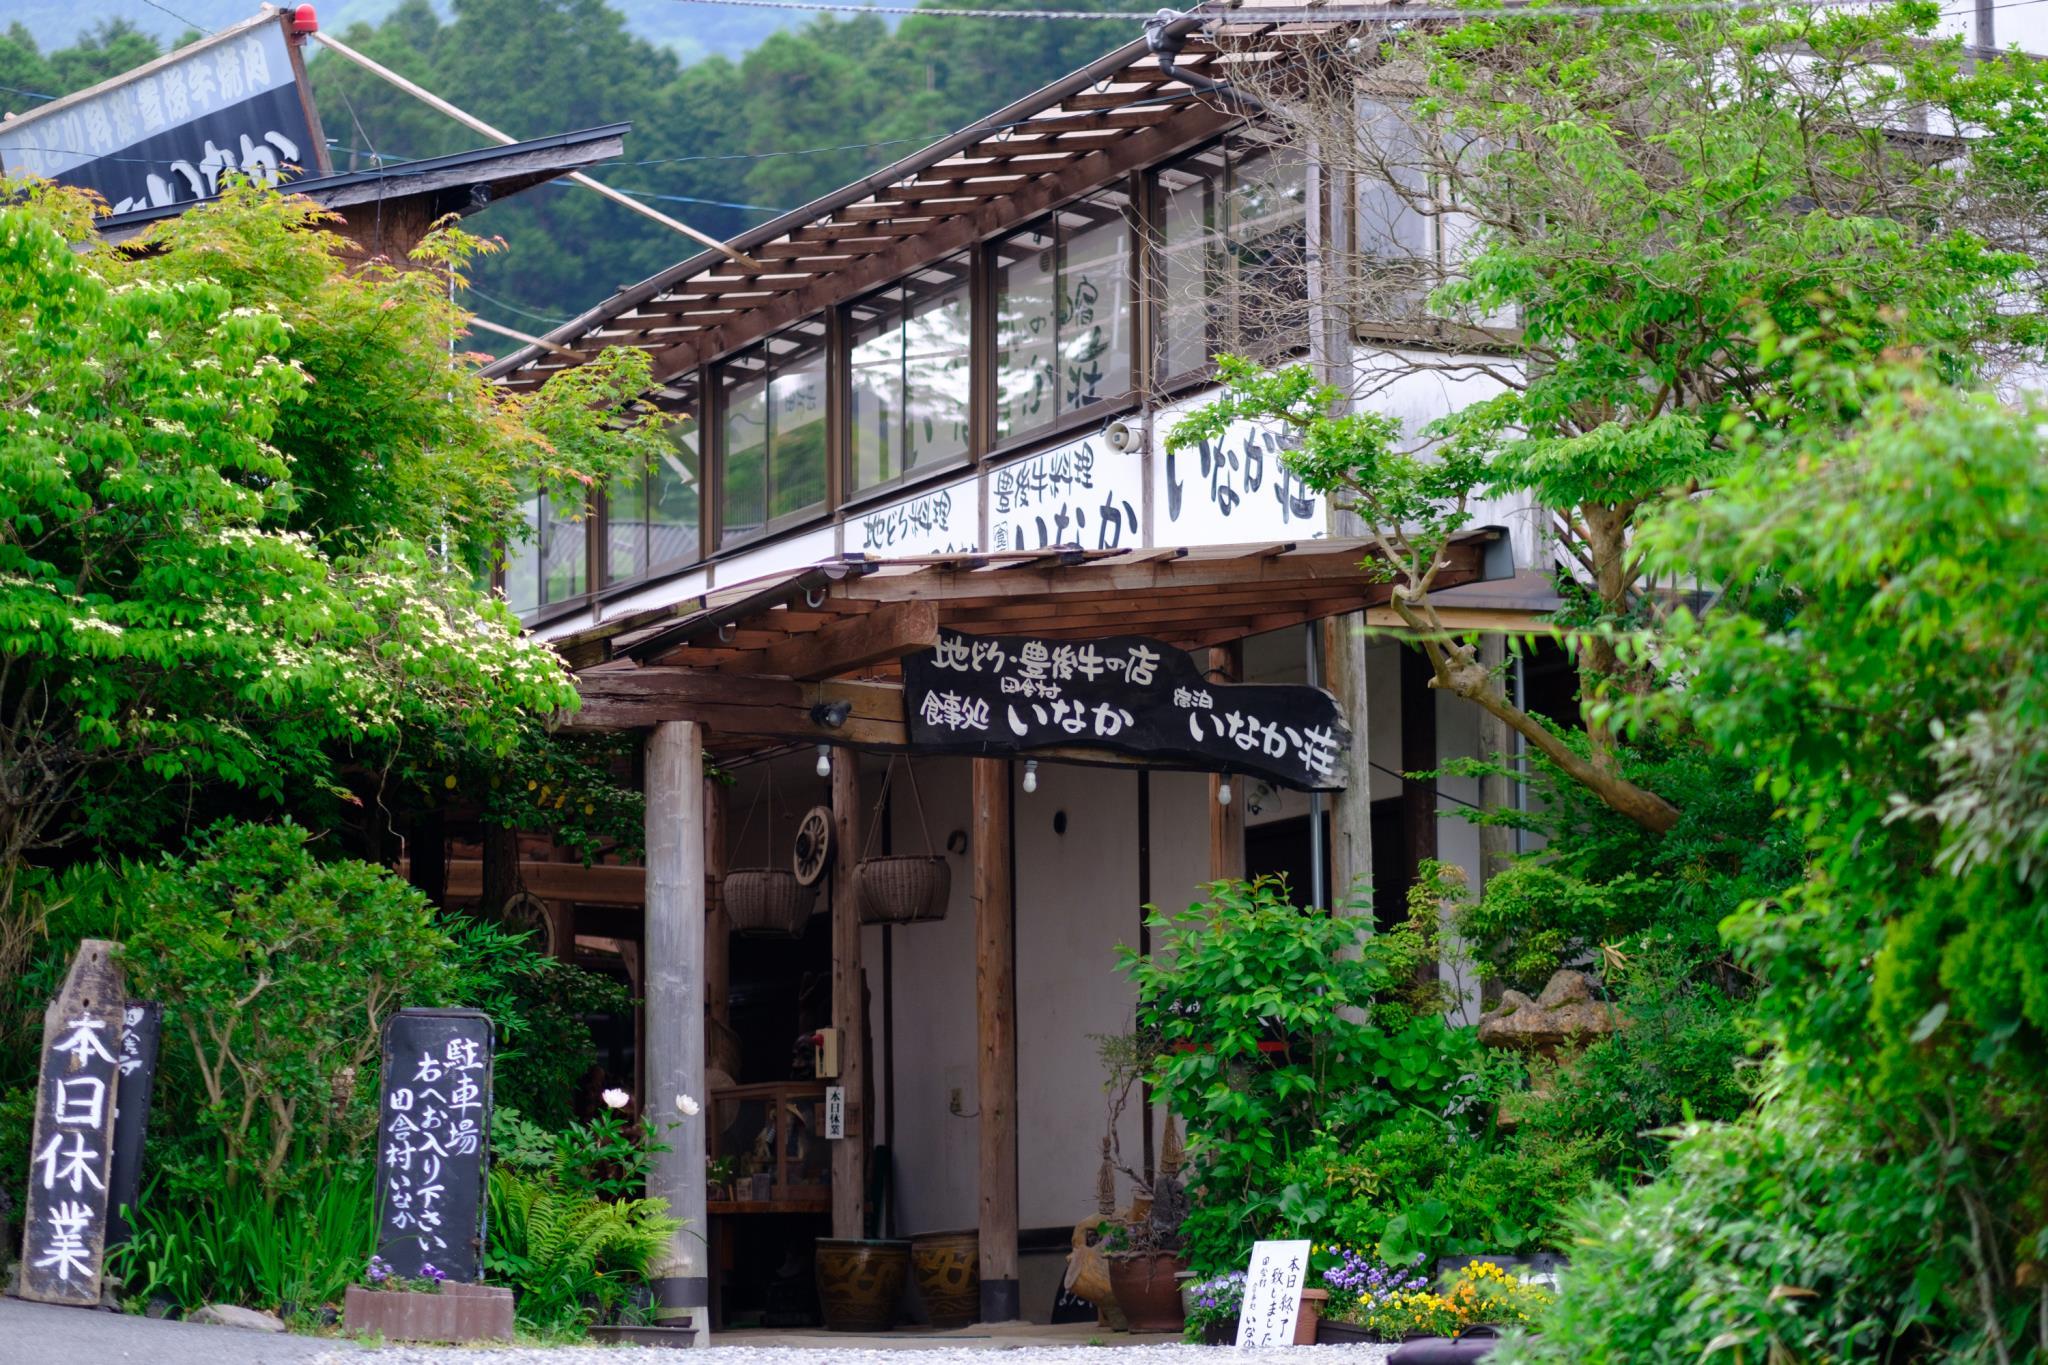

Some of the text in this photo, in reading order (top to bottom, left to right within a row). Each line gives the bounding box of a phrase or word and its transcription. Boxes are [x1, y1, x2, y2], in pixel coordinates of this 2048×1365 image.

[994, 441, 1094, 514] 豊後牛料理
[863, 489, 951, 549] 地どり料理
[931, 634, 1161, 686] 地どり・豊後牛の店
[1000, 676, 1062, 700] 田舎村
[920, 689, 1135, 737] 食事処 いなか
[1173, 686, 1214, 710] 宿泊
[1189, 710, 1338, 776] いなか荘
[442, 1038, 484, 1156] 駐車場
[830, 1090, 841, 1135] 本日休業
[34, 1011, 120, 1280] 本日休業
[386, 1088, 419, 1229] 田舎村いなか
[413, 1051, 449, 1251] 右へお入り下さい
[1280, 1255, 1300, 1338] 本日終了
